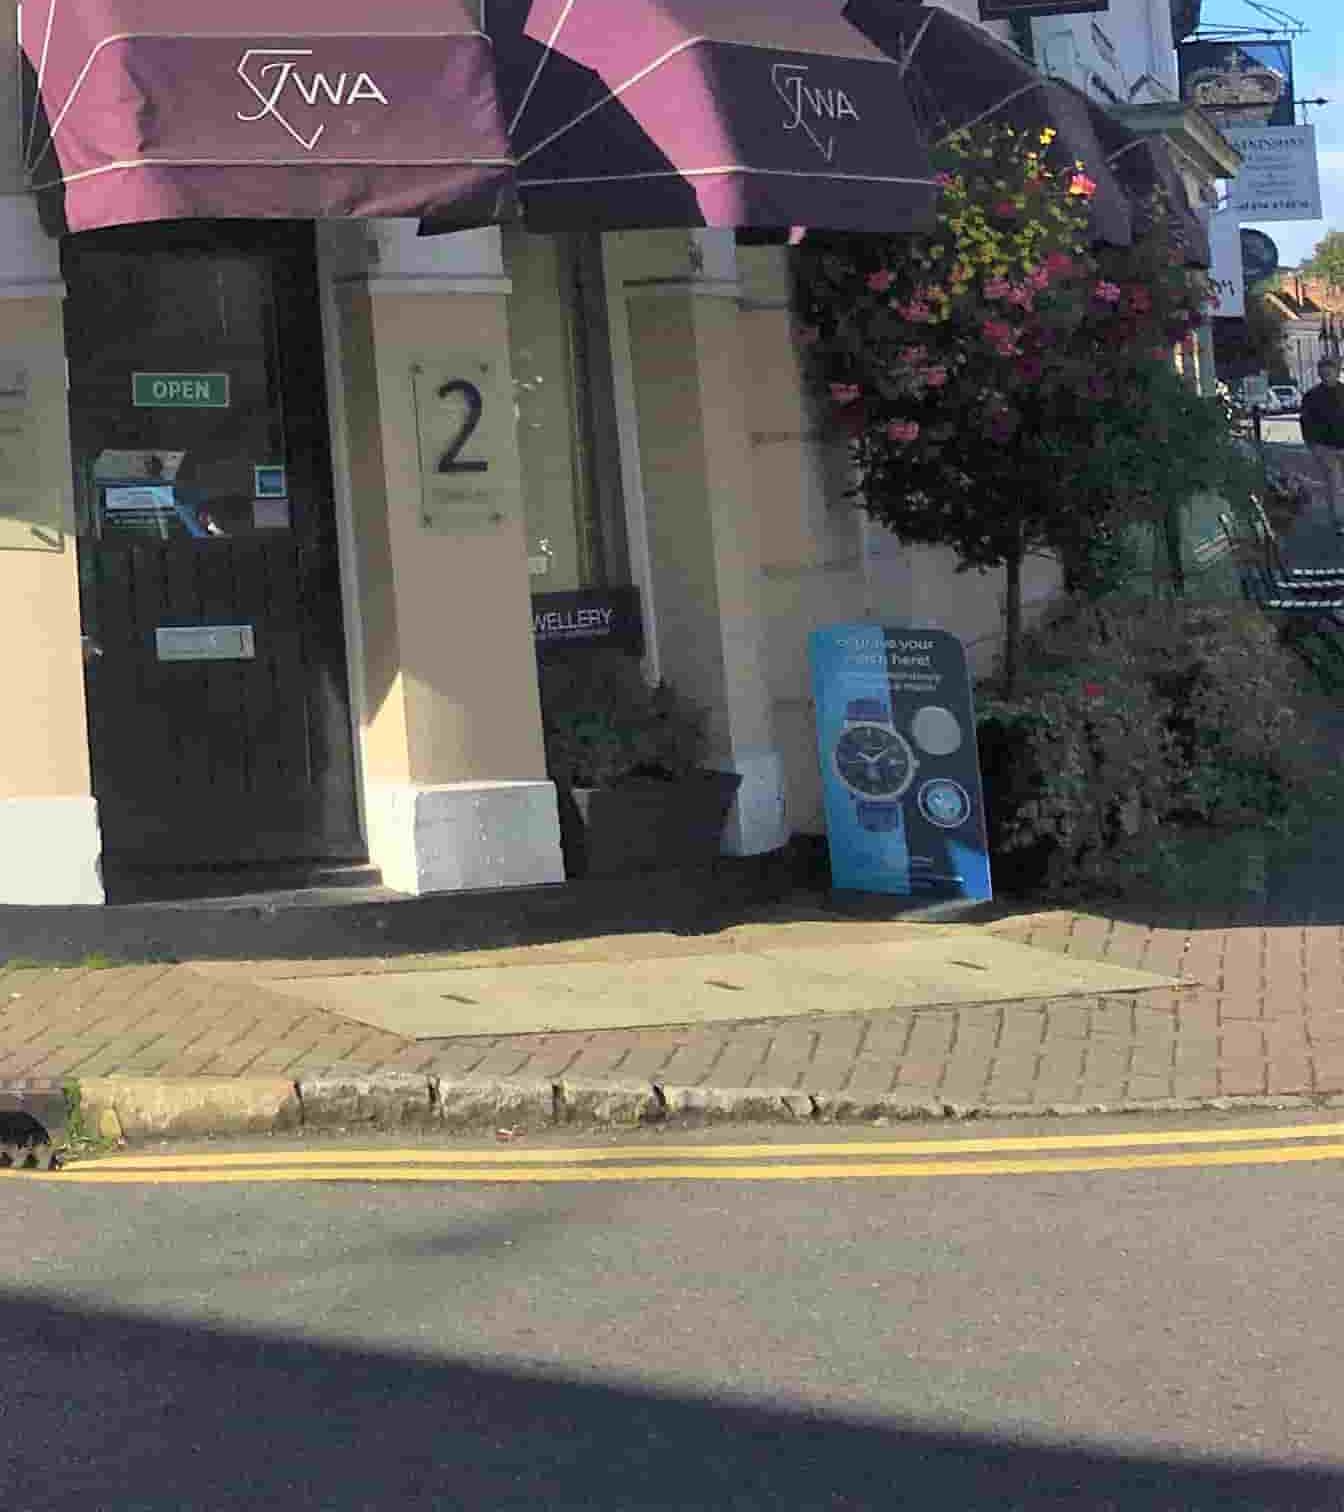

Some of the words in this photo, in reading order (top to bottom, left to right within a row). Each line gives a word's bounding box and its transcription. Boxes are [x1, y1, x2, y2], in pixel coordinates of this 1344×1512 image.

[238, 60, 390, 122] JWA
[782, 75, 861, 130] JWA
[152, 380, 211, 400] OPEN
[437, 378, 489, 473] 2
[898, 640, 935, 653] your
